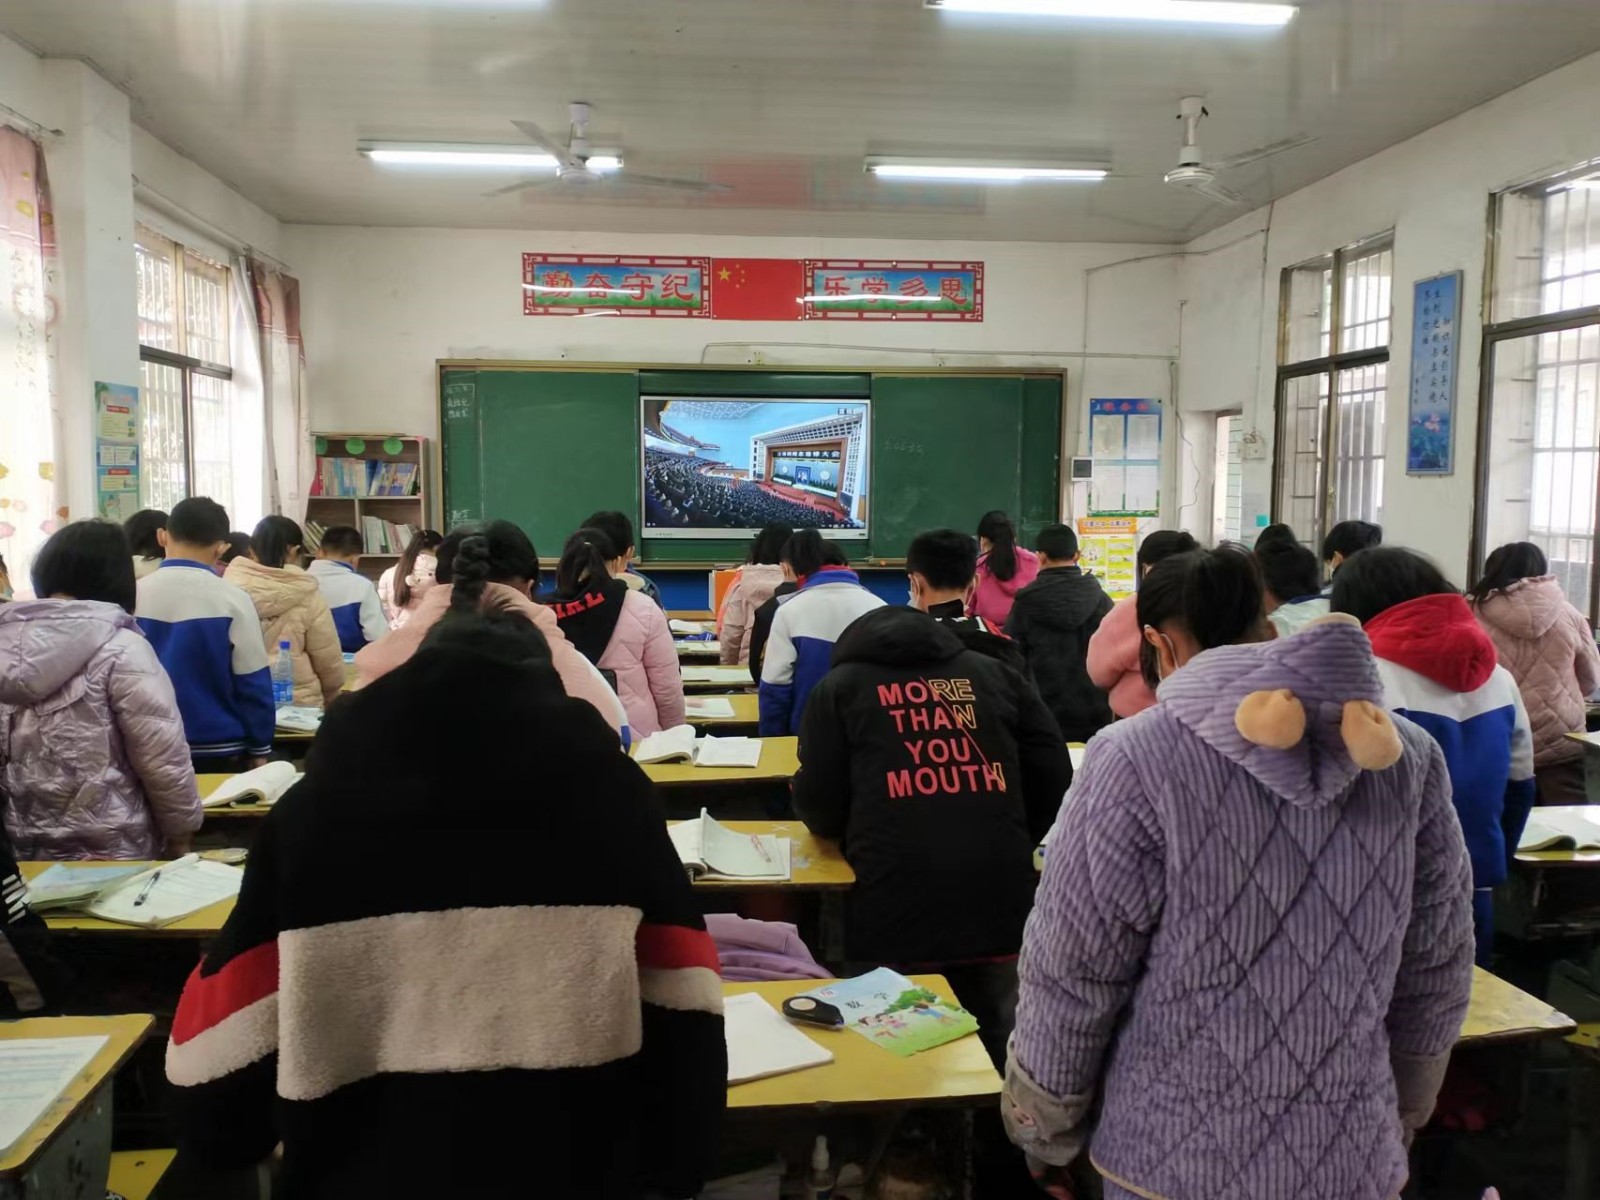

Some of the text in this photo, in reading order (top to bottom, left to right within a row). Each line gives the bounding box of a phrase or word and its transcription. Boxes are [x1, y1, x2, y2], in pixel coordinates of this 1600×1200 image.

[541, 270, 695, 301] 勤奋守纪
[823, 276, 968, 305] 乐学多思
[877, 679, 976, 706] MORE
[889, 704, 977, 733] THAN
[904, 737, 971, 765] YOU
[887, 762, 1006, 799] MOUTH
